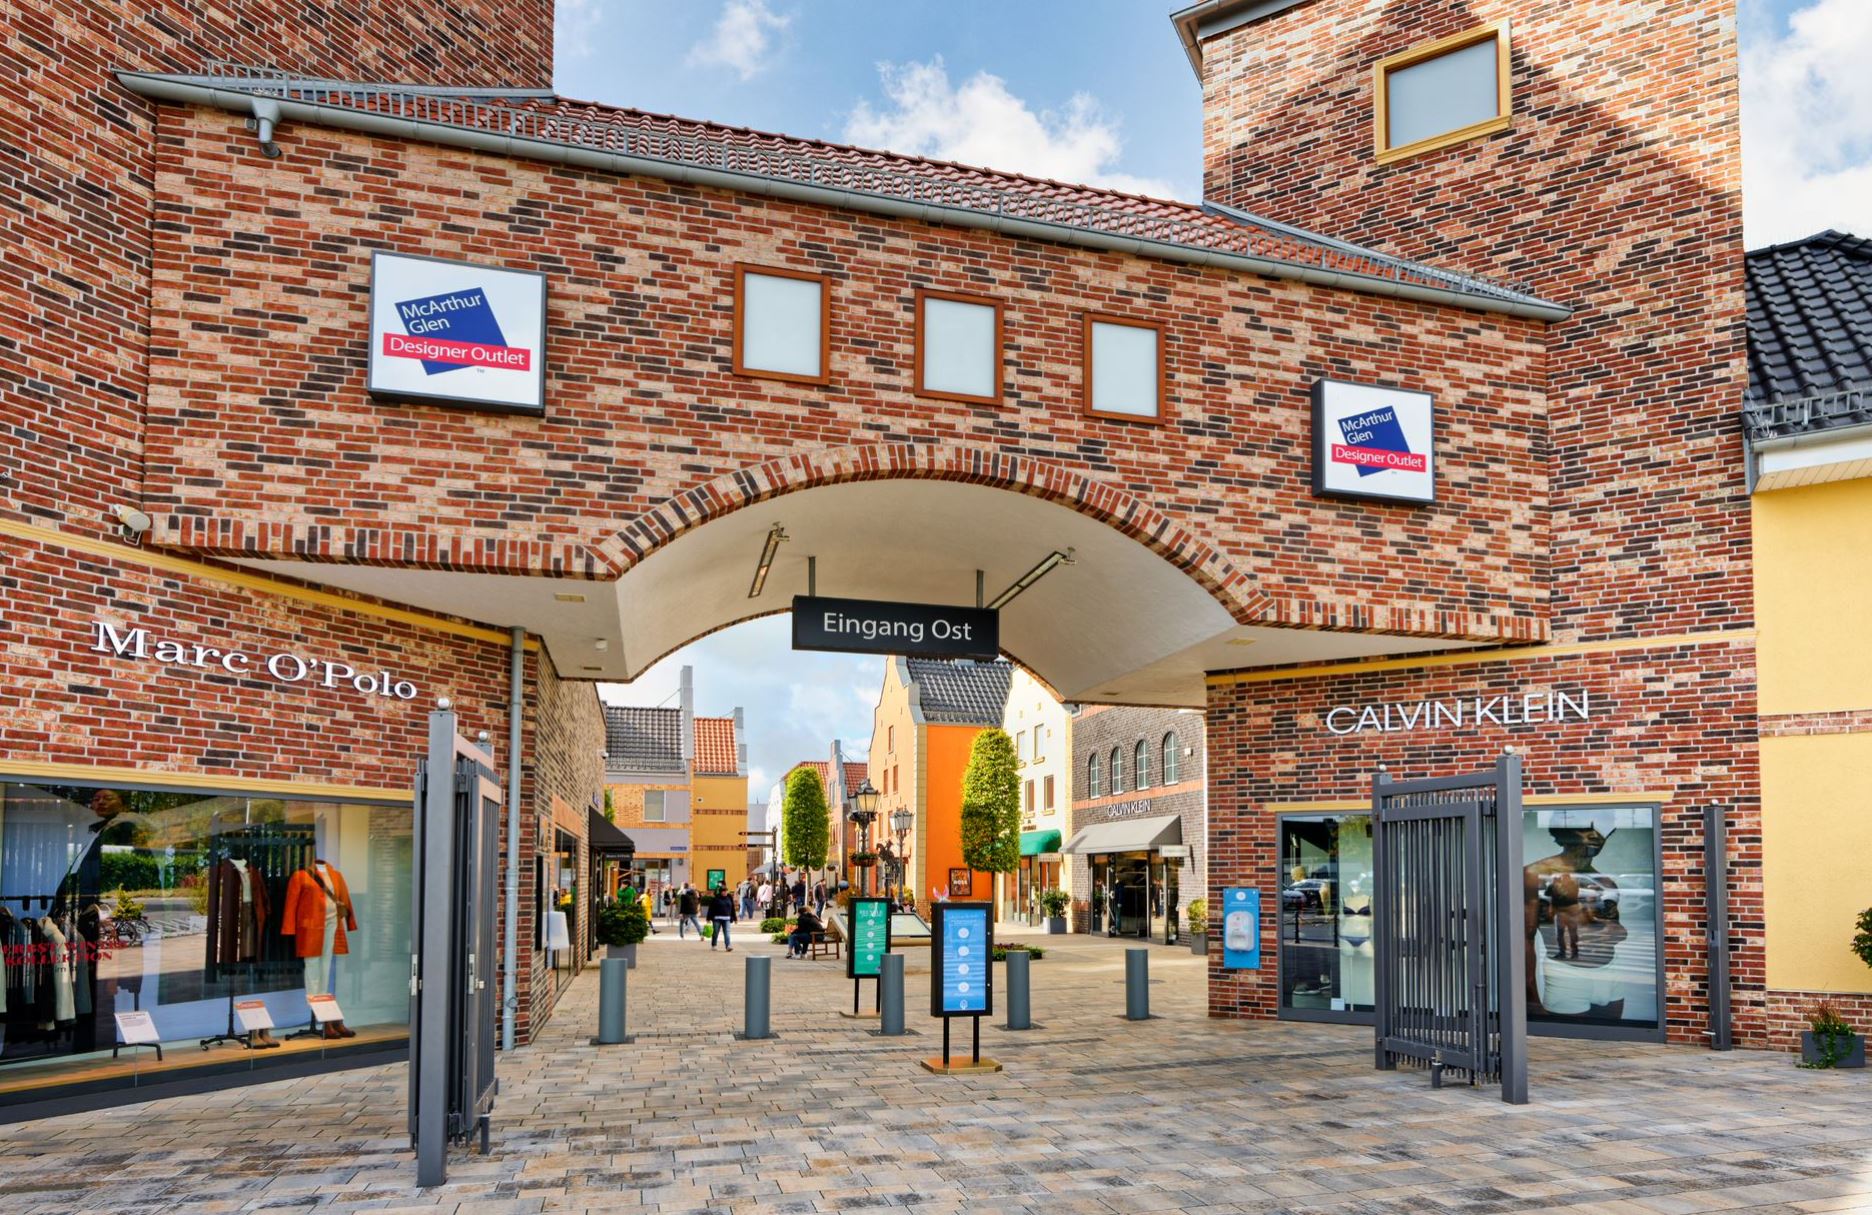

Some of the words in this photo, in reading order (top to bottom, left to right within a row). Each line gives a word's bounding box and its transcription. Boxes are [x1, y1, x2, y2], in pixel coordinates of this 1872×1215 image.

[402, 295, 481, 318] McArthur
[409, 319, 450, 333] Glen
[390, 337, 468, 358] Designer
[471, 347, 525, 366] Outlet
[1341, 411, 1393, 432] McArthur
[1346, 431, 1373, 444] Glen
[1335, 446, 1385, 464] Designer
[1387, 454, 1423, 468] Outlet
[823, 612, 924, 642] Eingang
[931, 619, 972, 640] Ost
[90, 620, 249, 674] Marc
[268, 653, 418, 700] O'Polo
[1326, 699, 1462, 734] CALVIN
[1475, 690, 1589, 726] KLEIN
[1107, 803, 1130, 817] CALVIN
[1131, 799, 1151, 813] KLEIN
